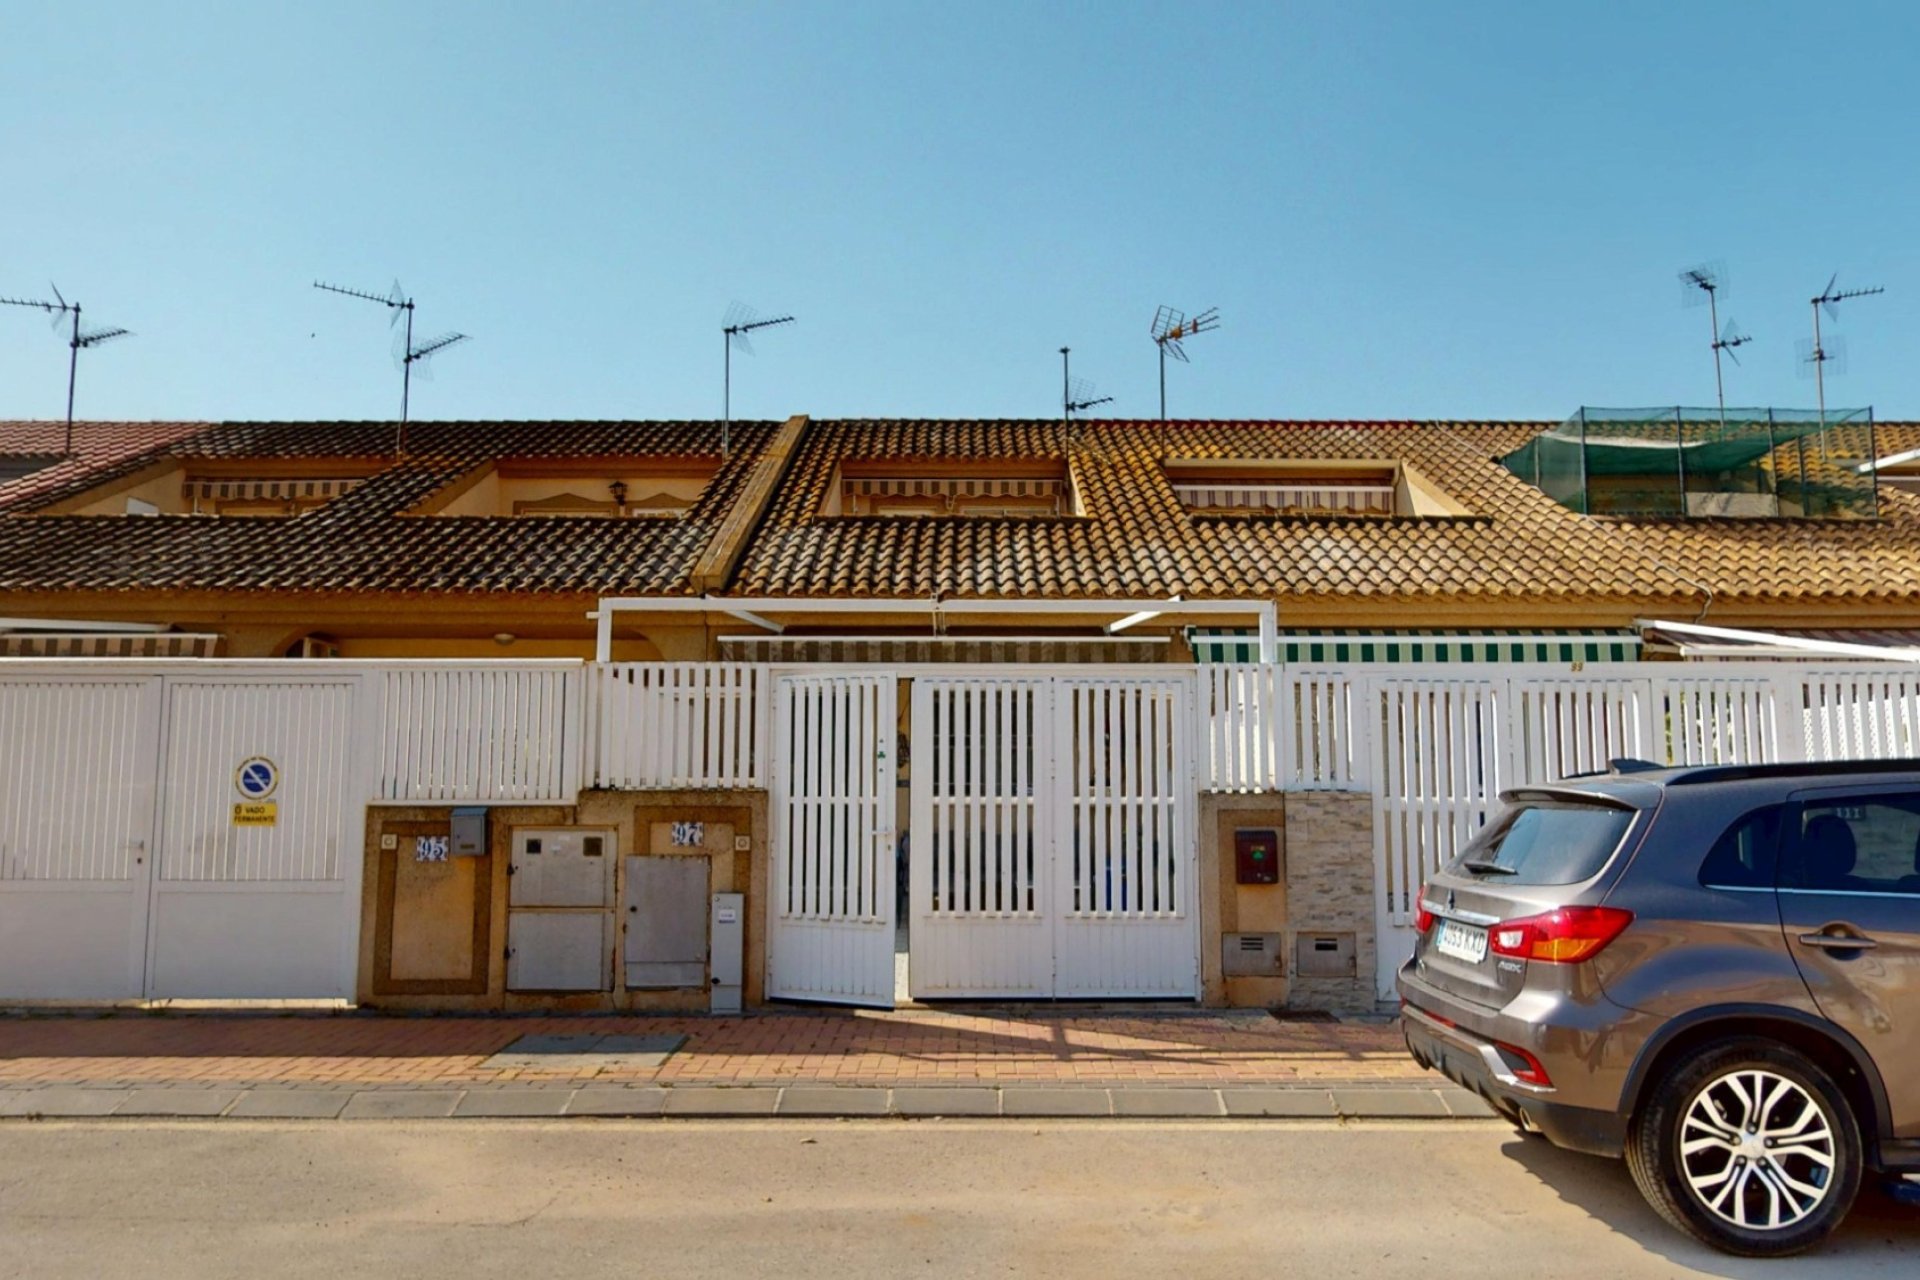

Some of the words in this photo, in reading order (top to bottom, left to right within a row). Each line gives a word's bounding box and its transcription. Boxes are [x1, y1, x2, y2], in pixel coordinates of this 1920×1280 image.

[245, 806, 265, 814] VADO
[676, 824, 698, 842] 97
[422, 840, 444, 858] 95
